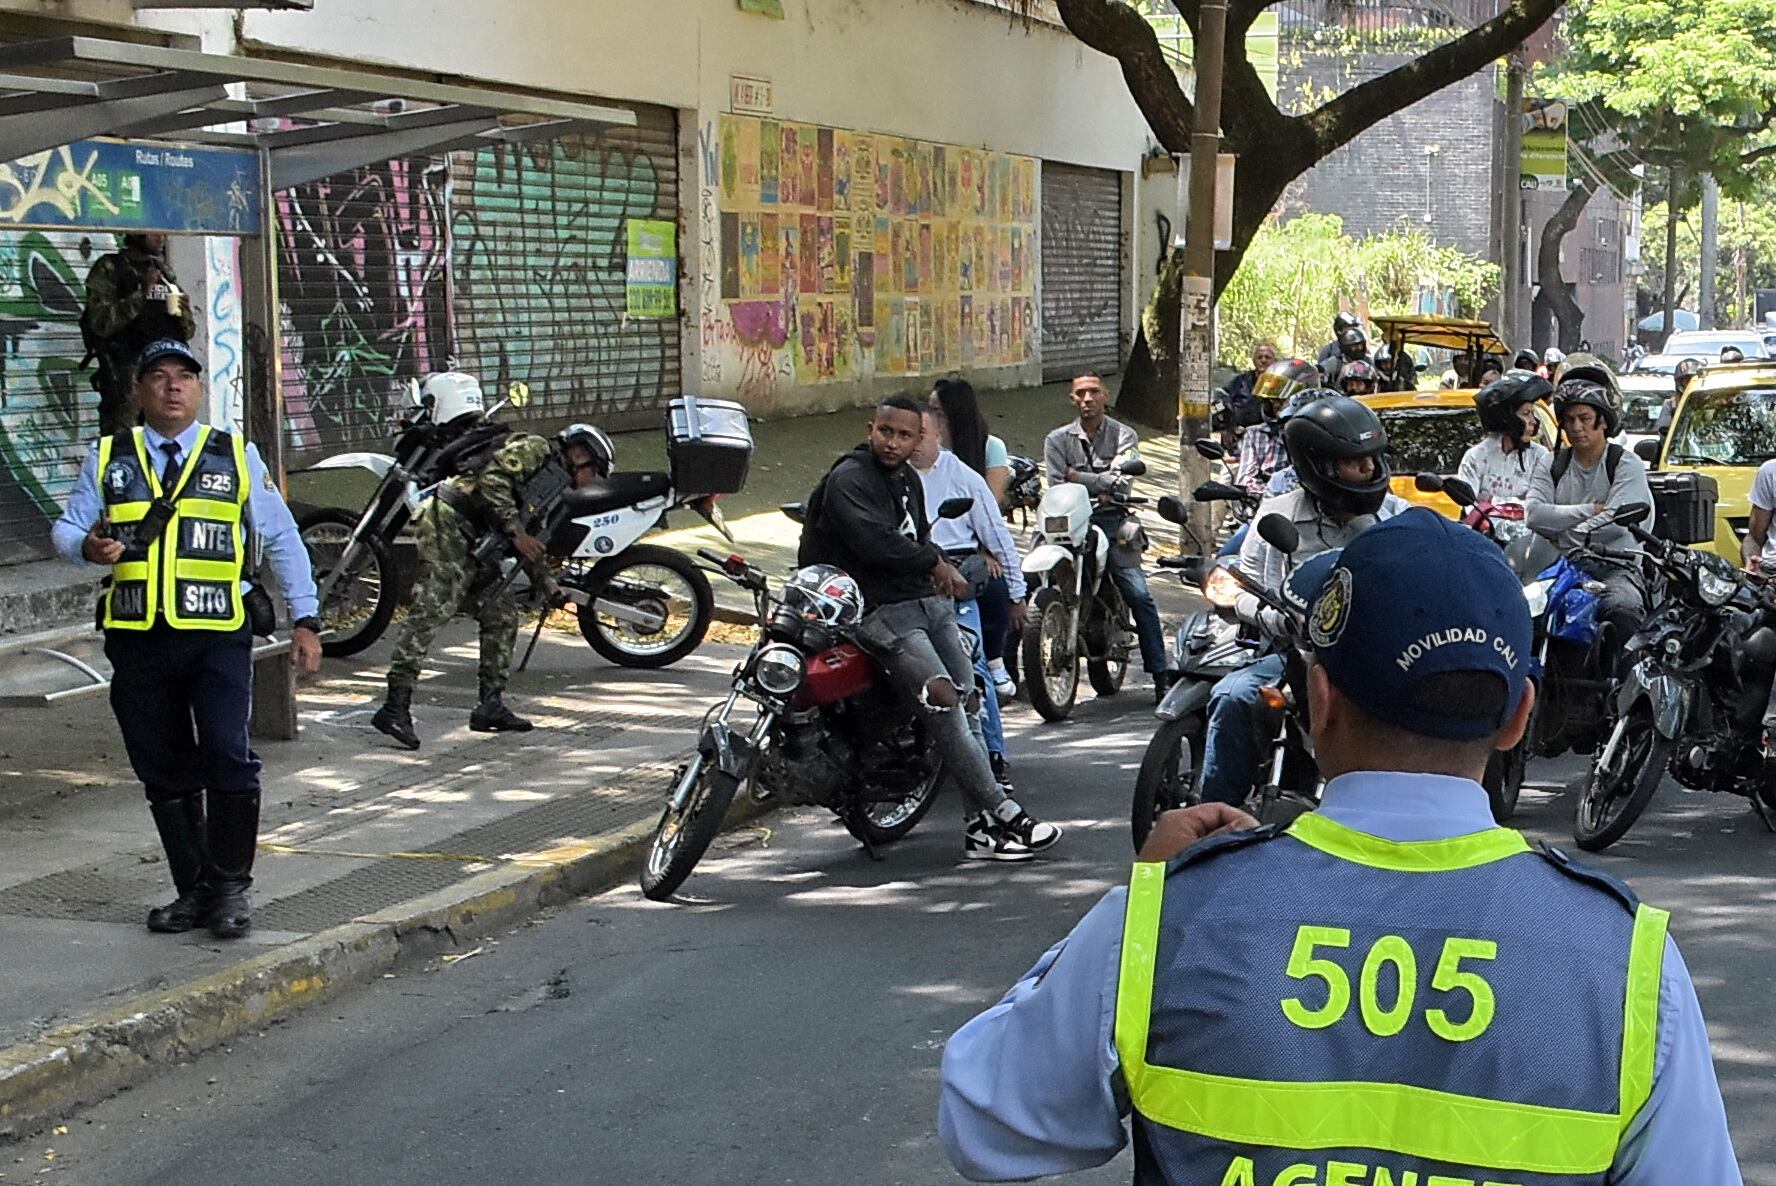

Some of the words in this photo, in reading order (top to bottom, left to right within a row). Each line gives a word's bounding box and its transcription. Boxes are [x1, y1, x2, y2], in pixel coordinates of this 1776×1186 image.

[136, 149, 160, 167] Rutas
[165, 152, 194, 168] Routes
[201, 474, 232, 493] 525
[592, 513, 620, 529] 250
[192, 521, 228, 551] NTE
[184, 585, 227, 614] SITO
[1396, 628, 1487, 672] MOVILIDAD
[1493, 637, 1519, 670] CALI
[1280, 925, 1499, 1042] 505
